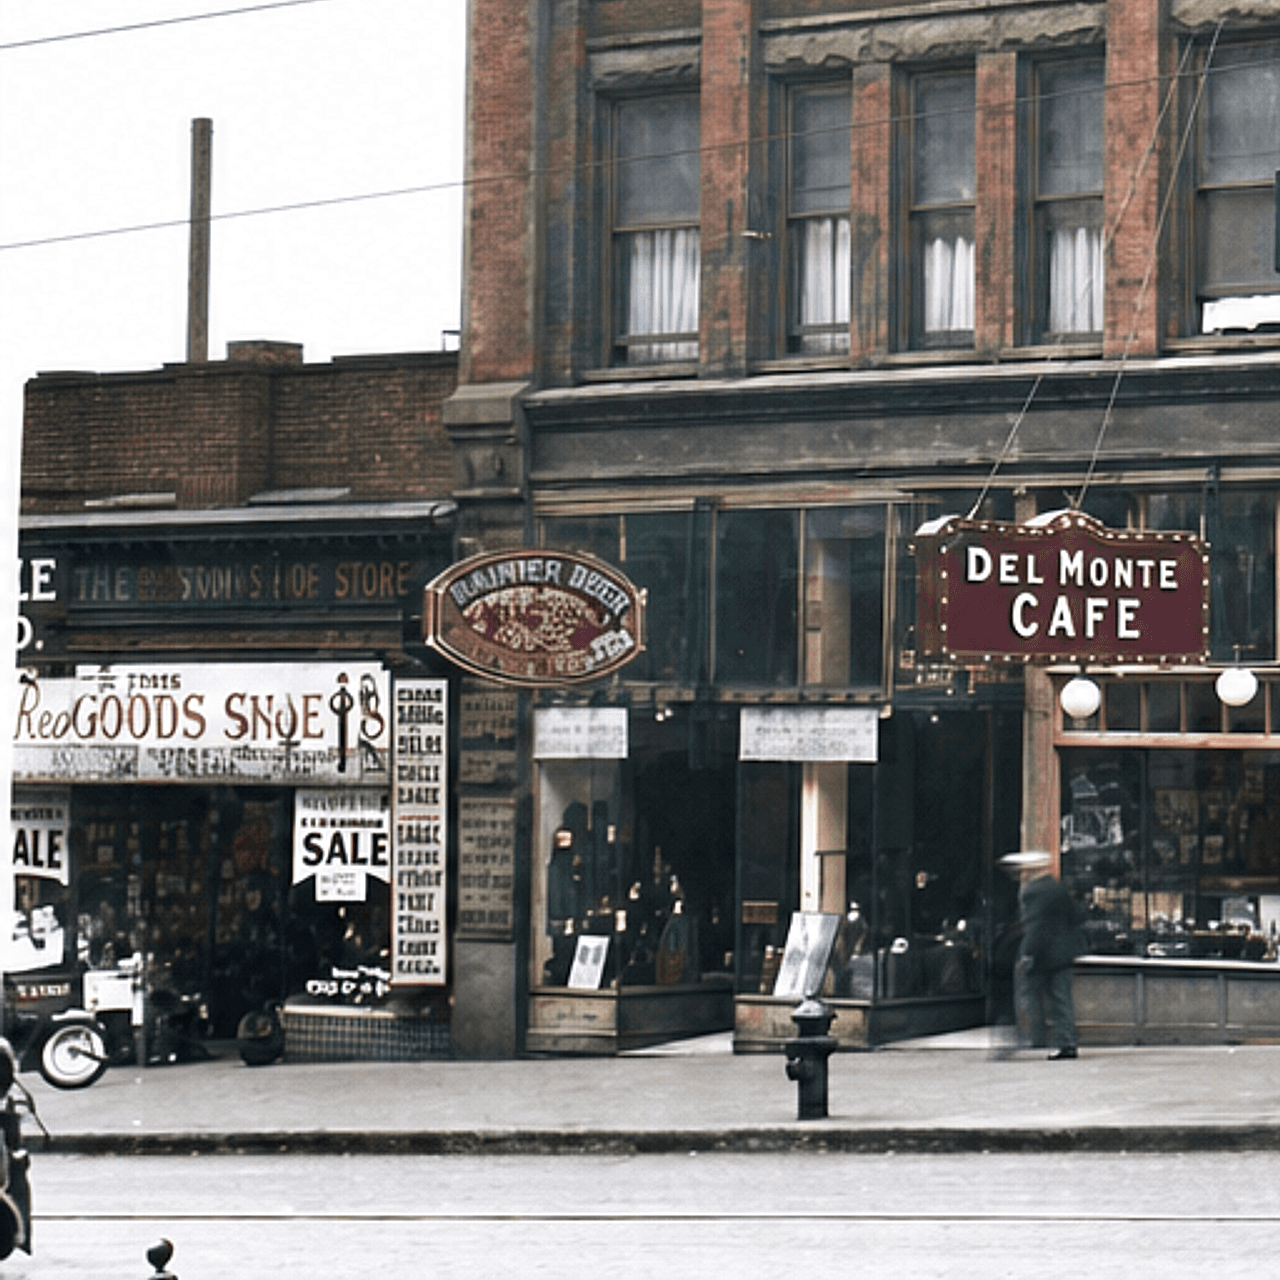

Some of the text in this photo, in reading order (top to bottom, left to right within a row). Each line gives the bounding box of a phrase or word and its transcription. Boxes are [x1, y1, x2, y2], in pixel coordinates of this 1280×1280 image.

[335, 561, 409, 599] STORE
[966, 546, 1179, 590] DEL MONTE
[1012, 591, 1142, 640] CAFE
[302, 830, 389, 866] SALE
